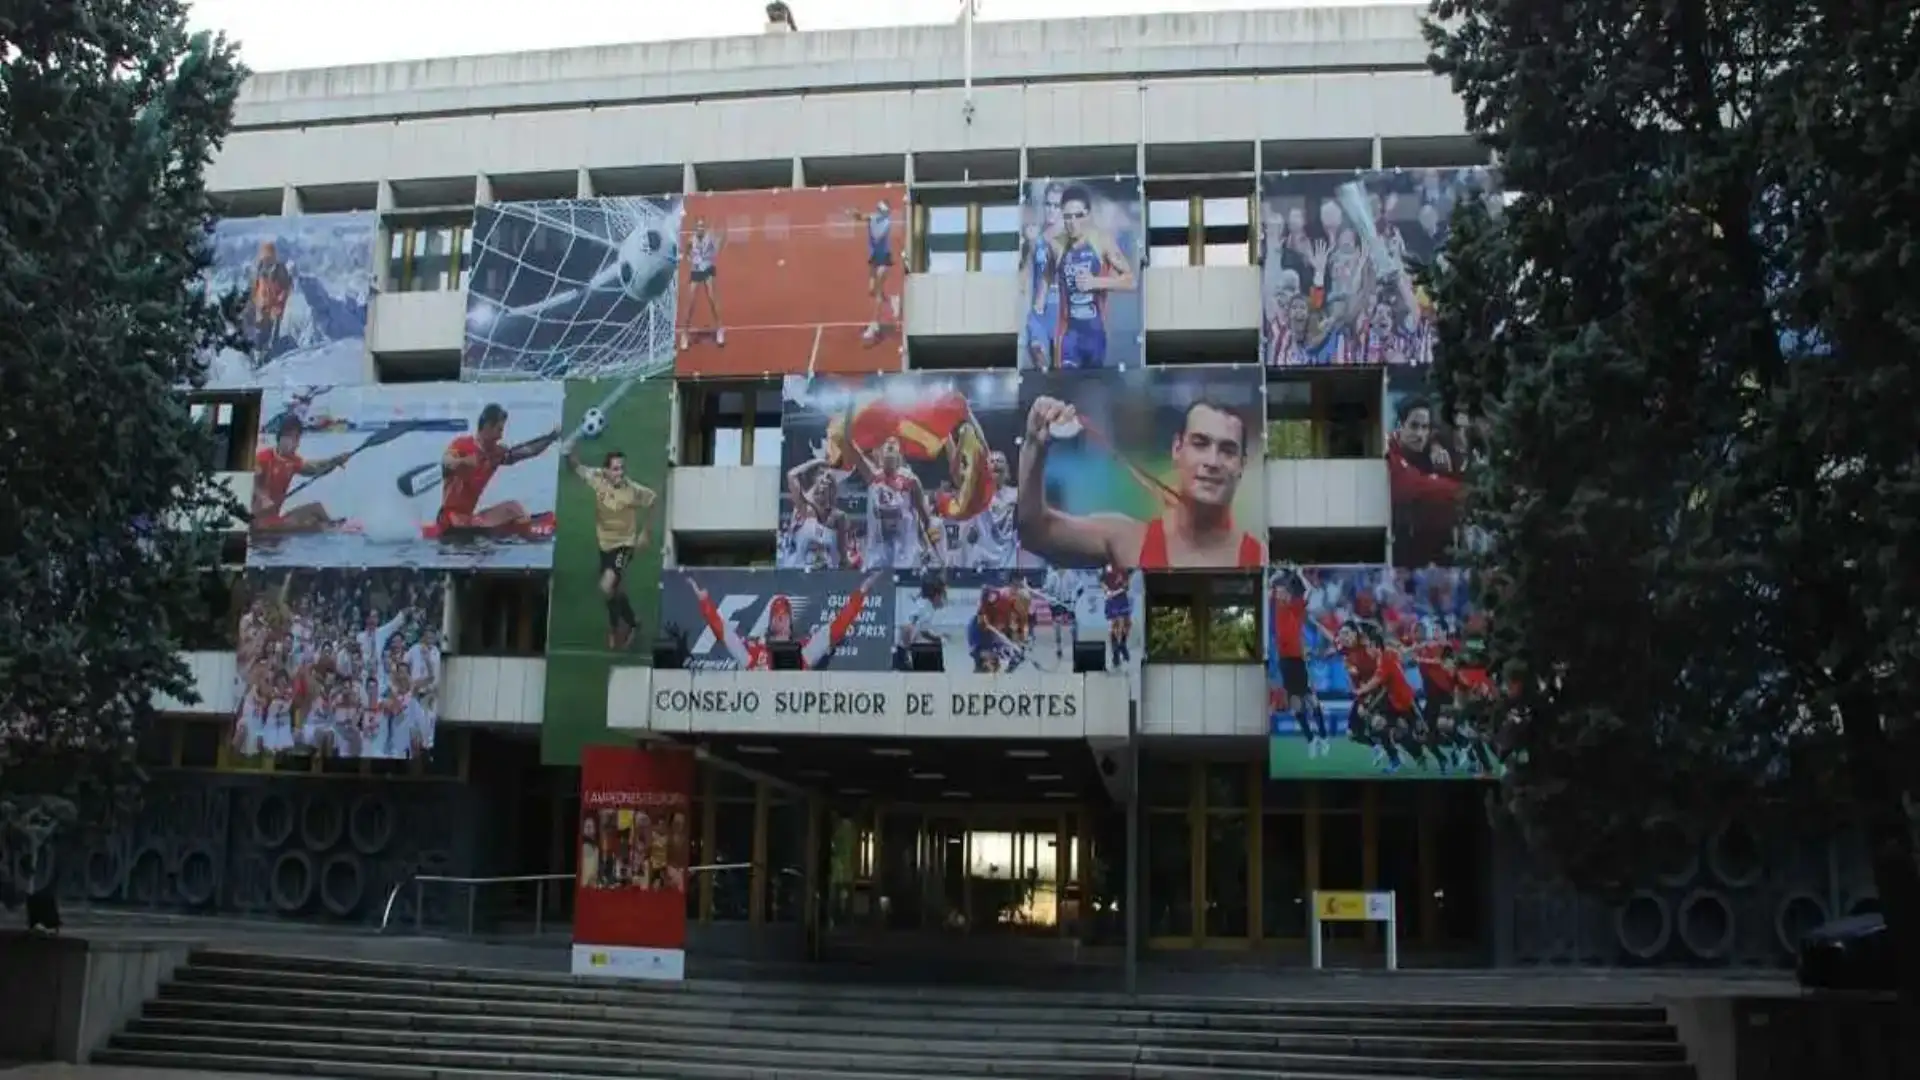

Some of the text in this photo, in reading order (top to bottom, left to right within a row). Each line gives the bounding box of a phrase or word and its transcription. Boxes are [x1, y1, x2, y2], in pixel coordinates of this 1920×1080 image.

[862, 595, 882, 607] AIR
[857, 624, 886, 638] PRIX
[655, 690, 1077, 717] CONSEJO SUPERIOR DE DEPORTES
